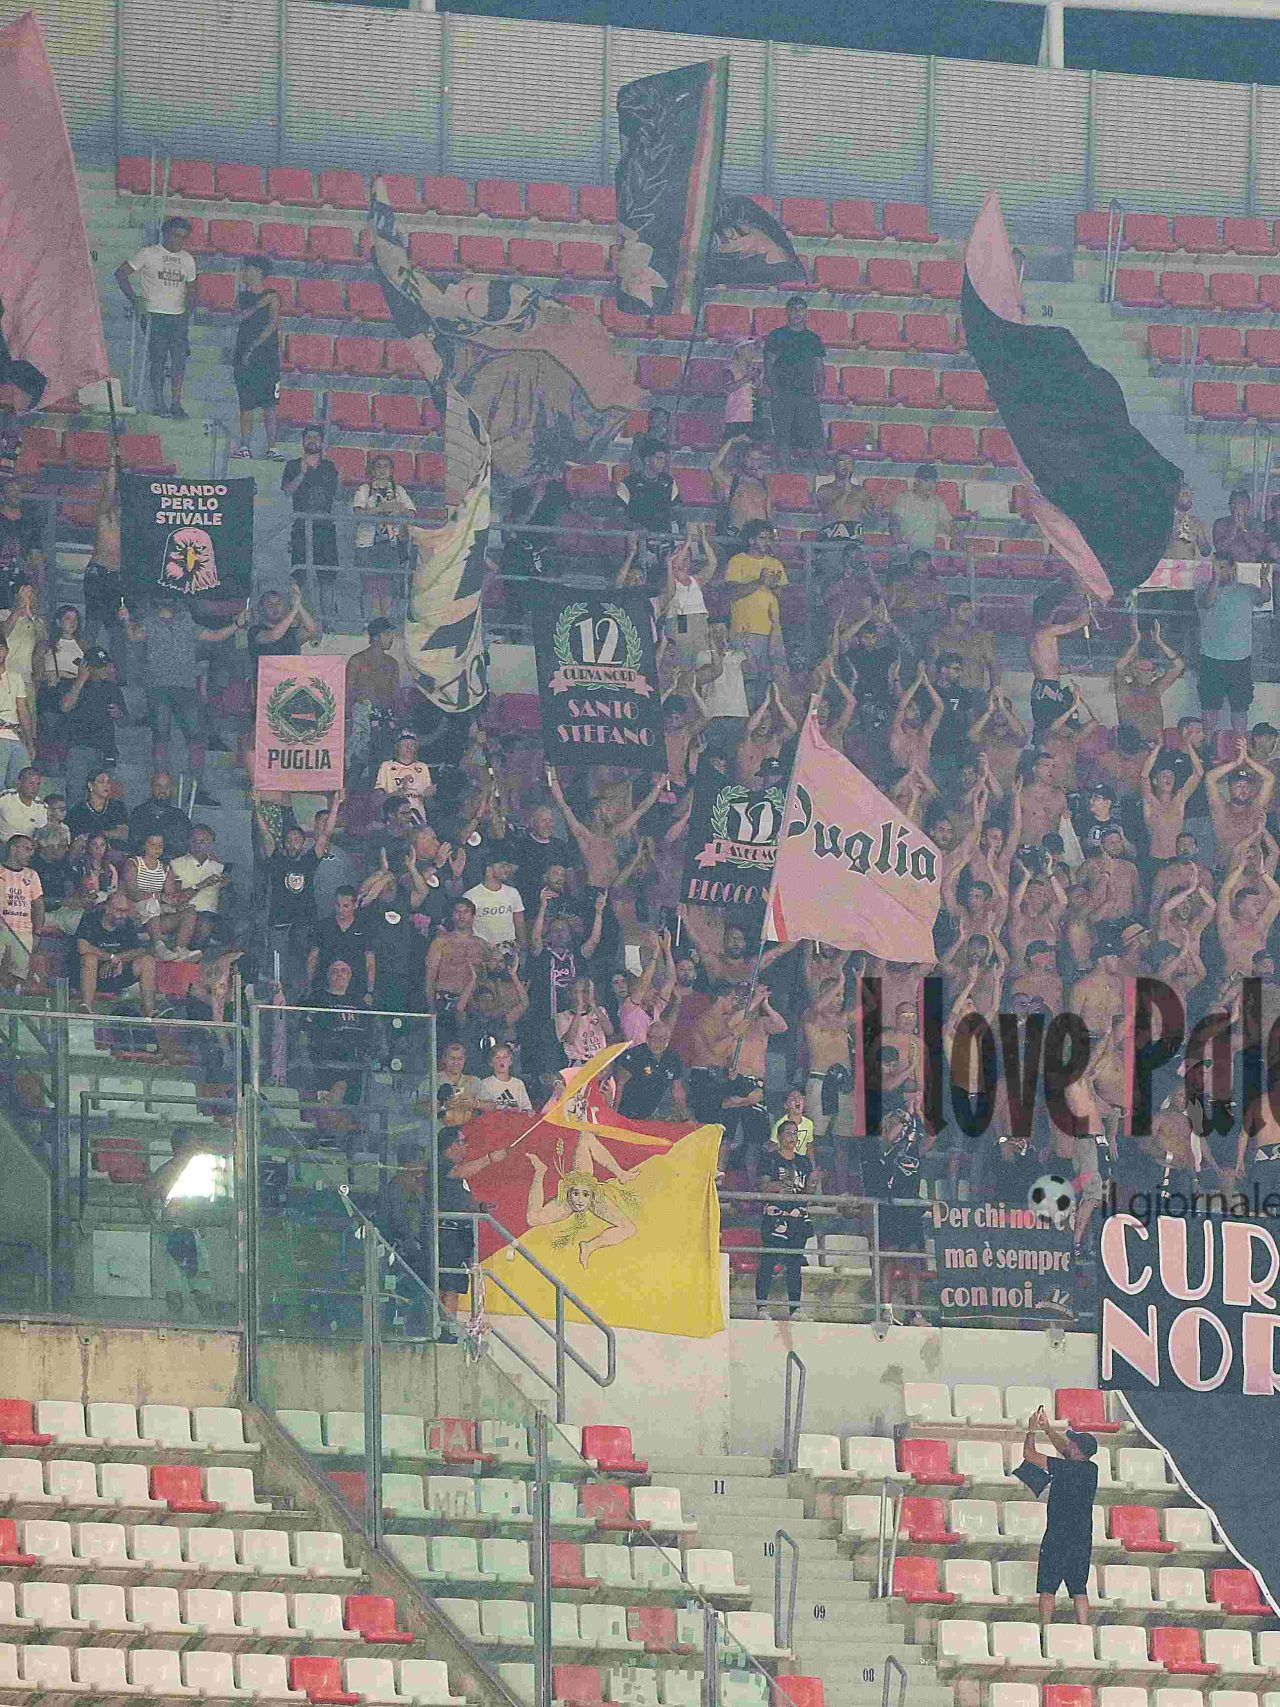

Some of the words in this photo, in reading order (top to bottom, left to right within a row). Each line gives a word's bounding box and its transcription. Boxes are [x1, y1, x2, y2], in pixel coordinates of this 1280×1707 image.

[1042, 304, 1053, 318] 30
[151, 483, 228, 496] GIRANDO
[161, 497, 194, 510] PER
[198, 498, 218, 510] LO
[156, 512, 222, 526] STIVALE
[575, 618, 622, 664] 12
[568, 700, 639, 720] SANTO
[557, 725, 655, 747] STEFANO
[267, 749, 332, 769] PUGLIA
[688, 879, 759, 904] BLOCCO
[932, 1200, 971, 1228] Per
[974, 1202, 1006, 1228] chi
[944, 1248, 978, 1269] ma
[982, 1241, 993, 1267] è
[996, 1249, 1071, 1276] sempre
[940, 1287, 988, 1307] con
[992, 1281, 1033, 1308] noi
[713, 1480, 725, 1494] 11
[763, 1542, 774, 1557] 10
[813, 1605, 826, 1619] 09
[863, 1668, 875, 1682] 08
